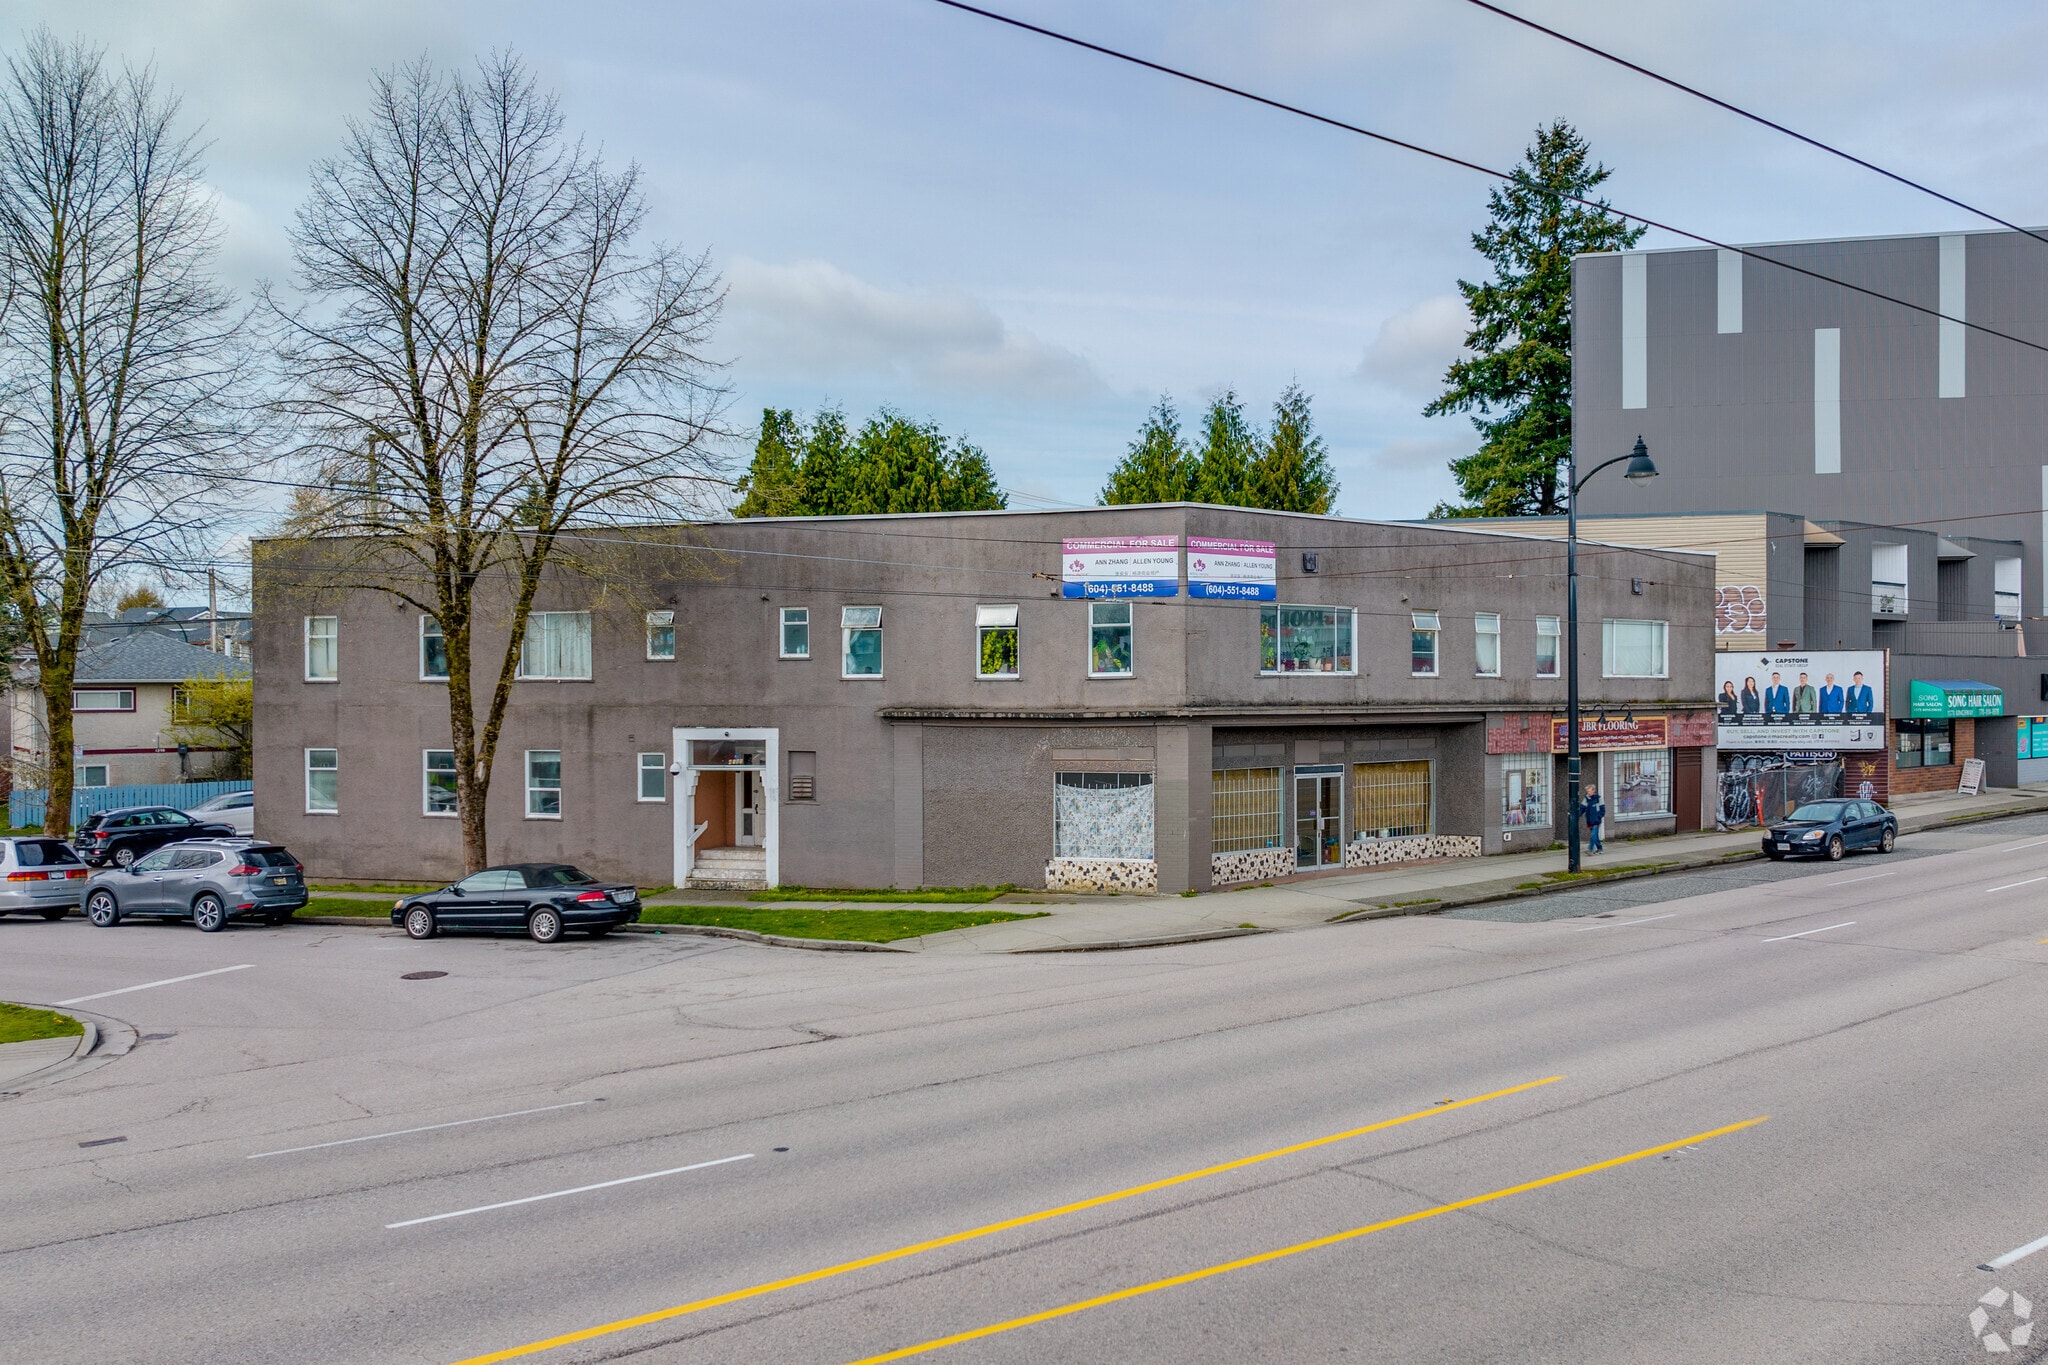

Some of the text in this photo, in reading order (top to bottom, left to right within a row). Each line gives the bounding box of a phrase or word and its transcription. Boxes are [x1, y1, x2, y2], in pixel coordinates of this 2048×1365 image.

[1066, 540, 1127, 550] COMMERCIAL
[1150, 539, 1175, 547] SALE
[1191, 540, 1239, 551] COMMERCIAL
[1206, 585, 1259, 596] (604)-551-8488
[1948, 695, 2002, 707] SONG HAIR SALON
[1581, 720, 1638, 731] JBR FLOORING
